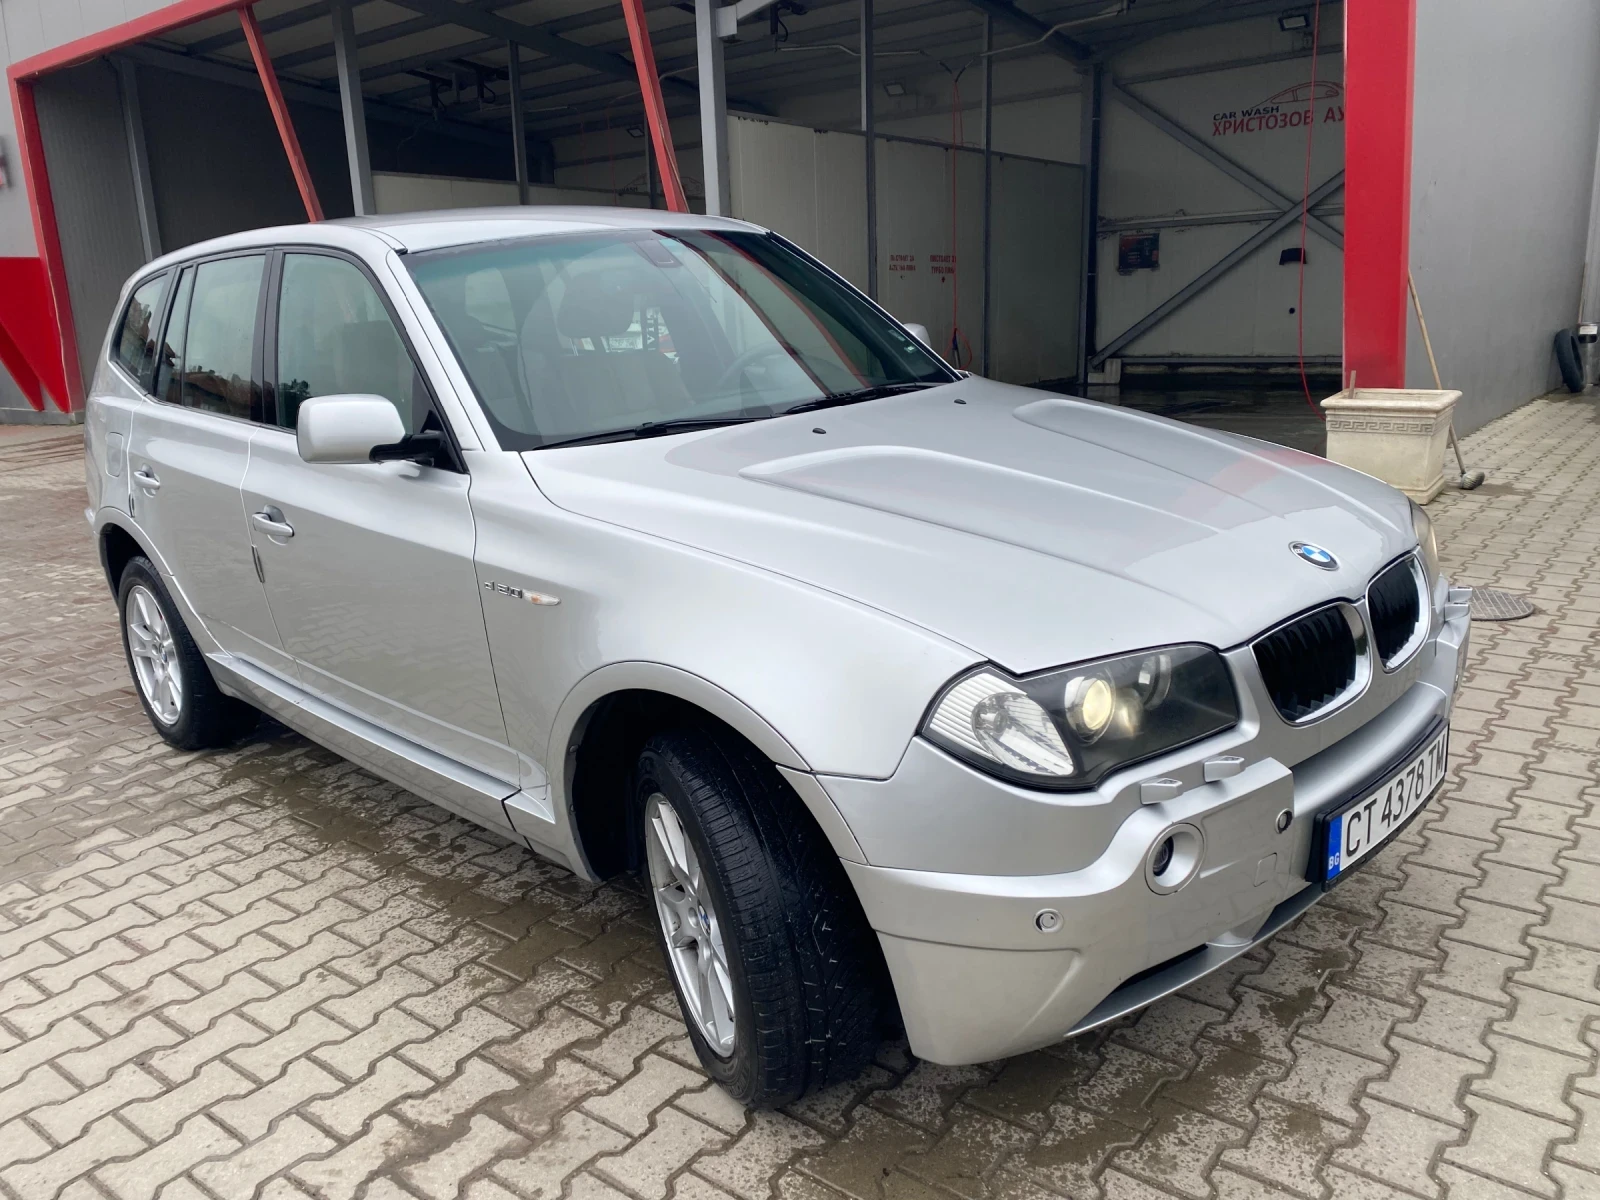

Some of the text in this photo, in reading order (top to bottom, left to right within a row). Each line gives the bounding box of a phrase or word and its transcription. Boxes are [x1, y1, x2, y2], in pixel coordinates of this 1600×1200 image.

[1212, 109, 1314, 137] ХРИСТОЗОВ
[1213, 105, 1280, 121] CAR WASH
[1346, 733, 1446, 857] CT 4378 TM
[1328, 852, 1340, 870] BG
